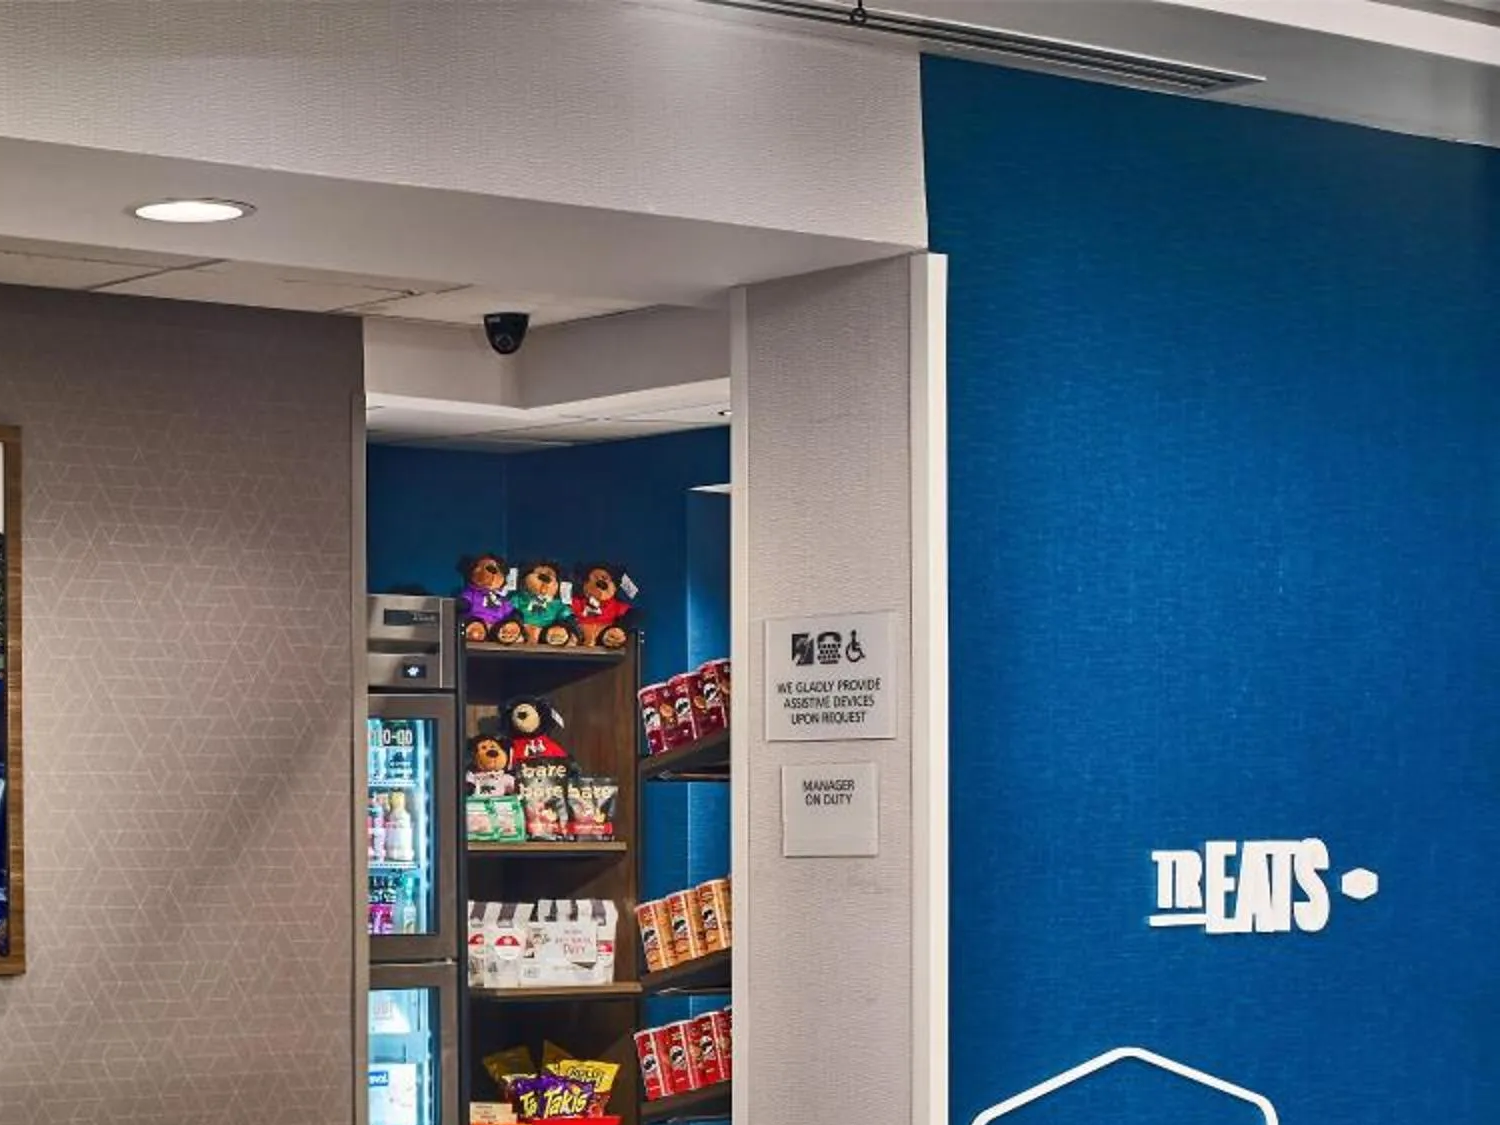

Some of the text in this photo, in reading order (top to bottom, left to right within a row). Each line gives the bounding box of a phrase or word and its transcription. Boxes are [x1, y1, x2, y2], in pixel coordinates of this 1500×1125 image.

[777, 677, 882, 694] WE GLADLY PROVIDE
[783, 694, 875, 709] ASSISTIVE DEVICES
[791, 711, 866, 725] UPON REQUEST
[521, 763, 567, 778] bare
[803, 779, 855, 792] MANAGER
[805, 792, 853, 806] ON DUTY
[1151, 837, 1330, 933] TREATS
[543, 1085, 589, 1119] Takis
